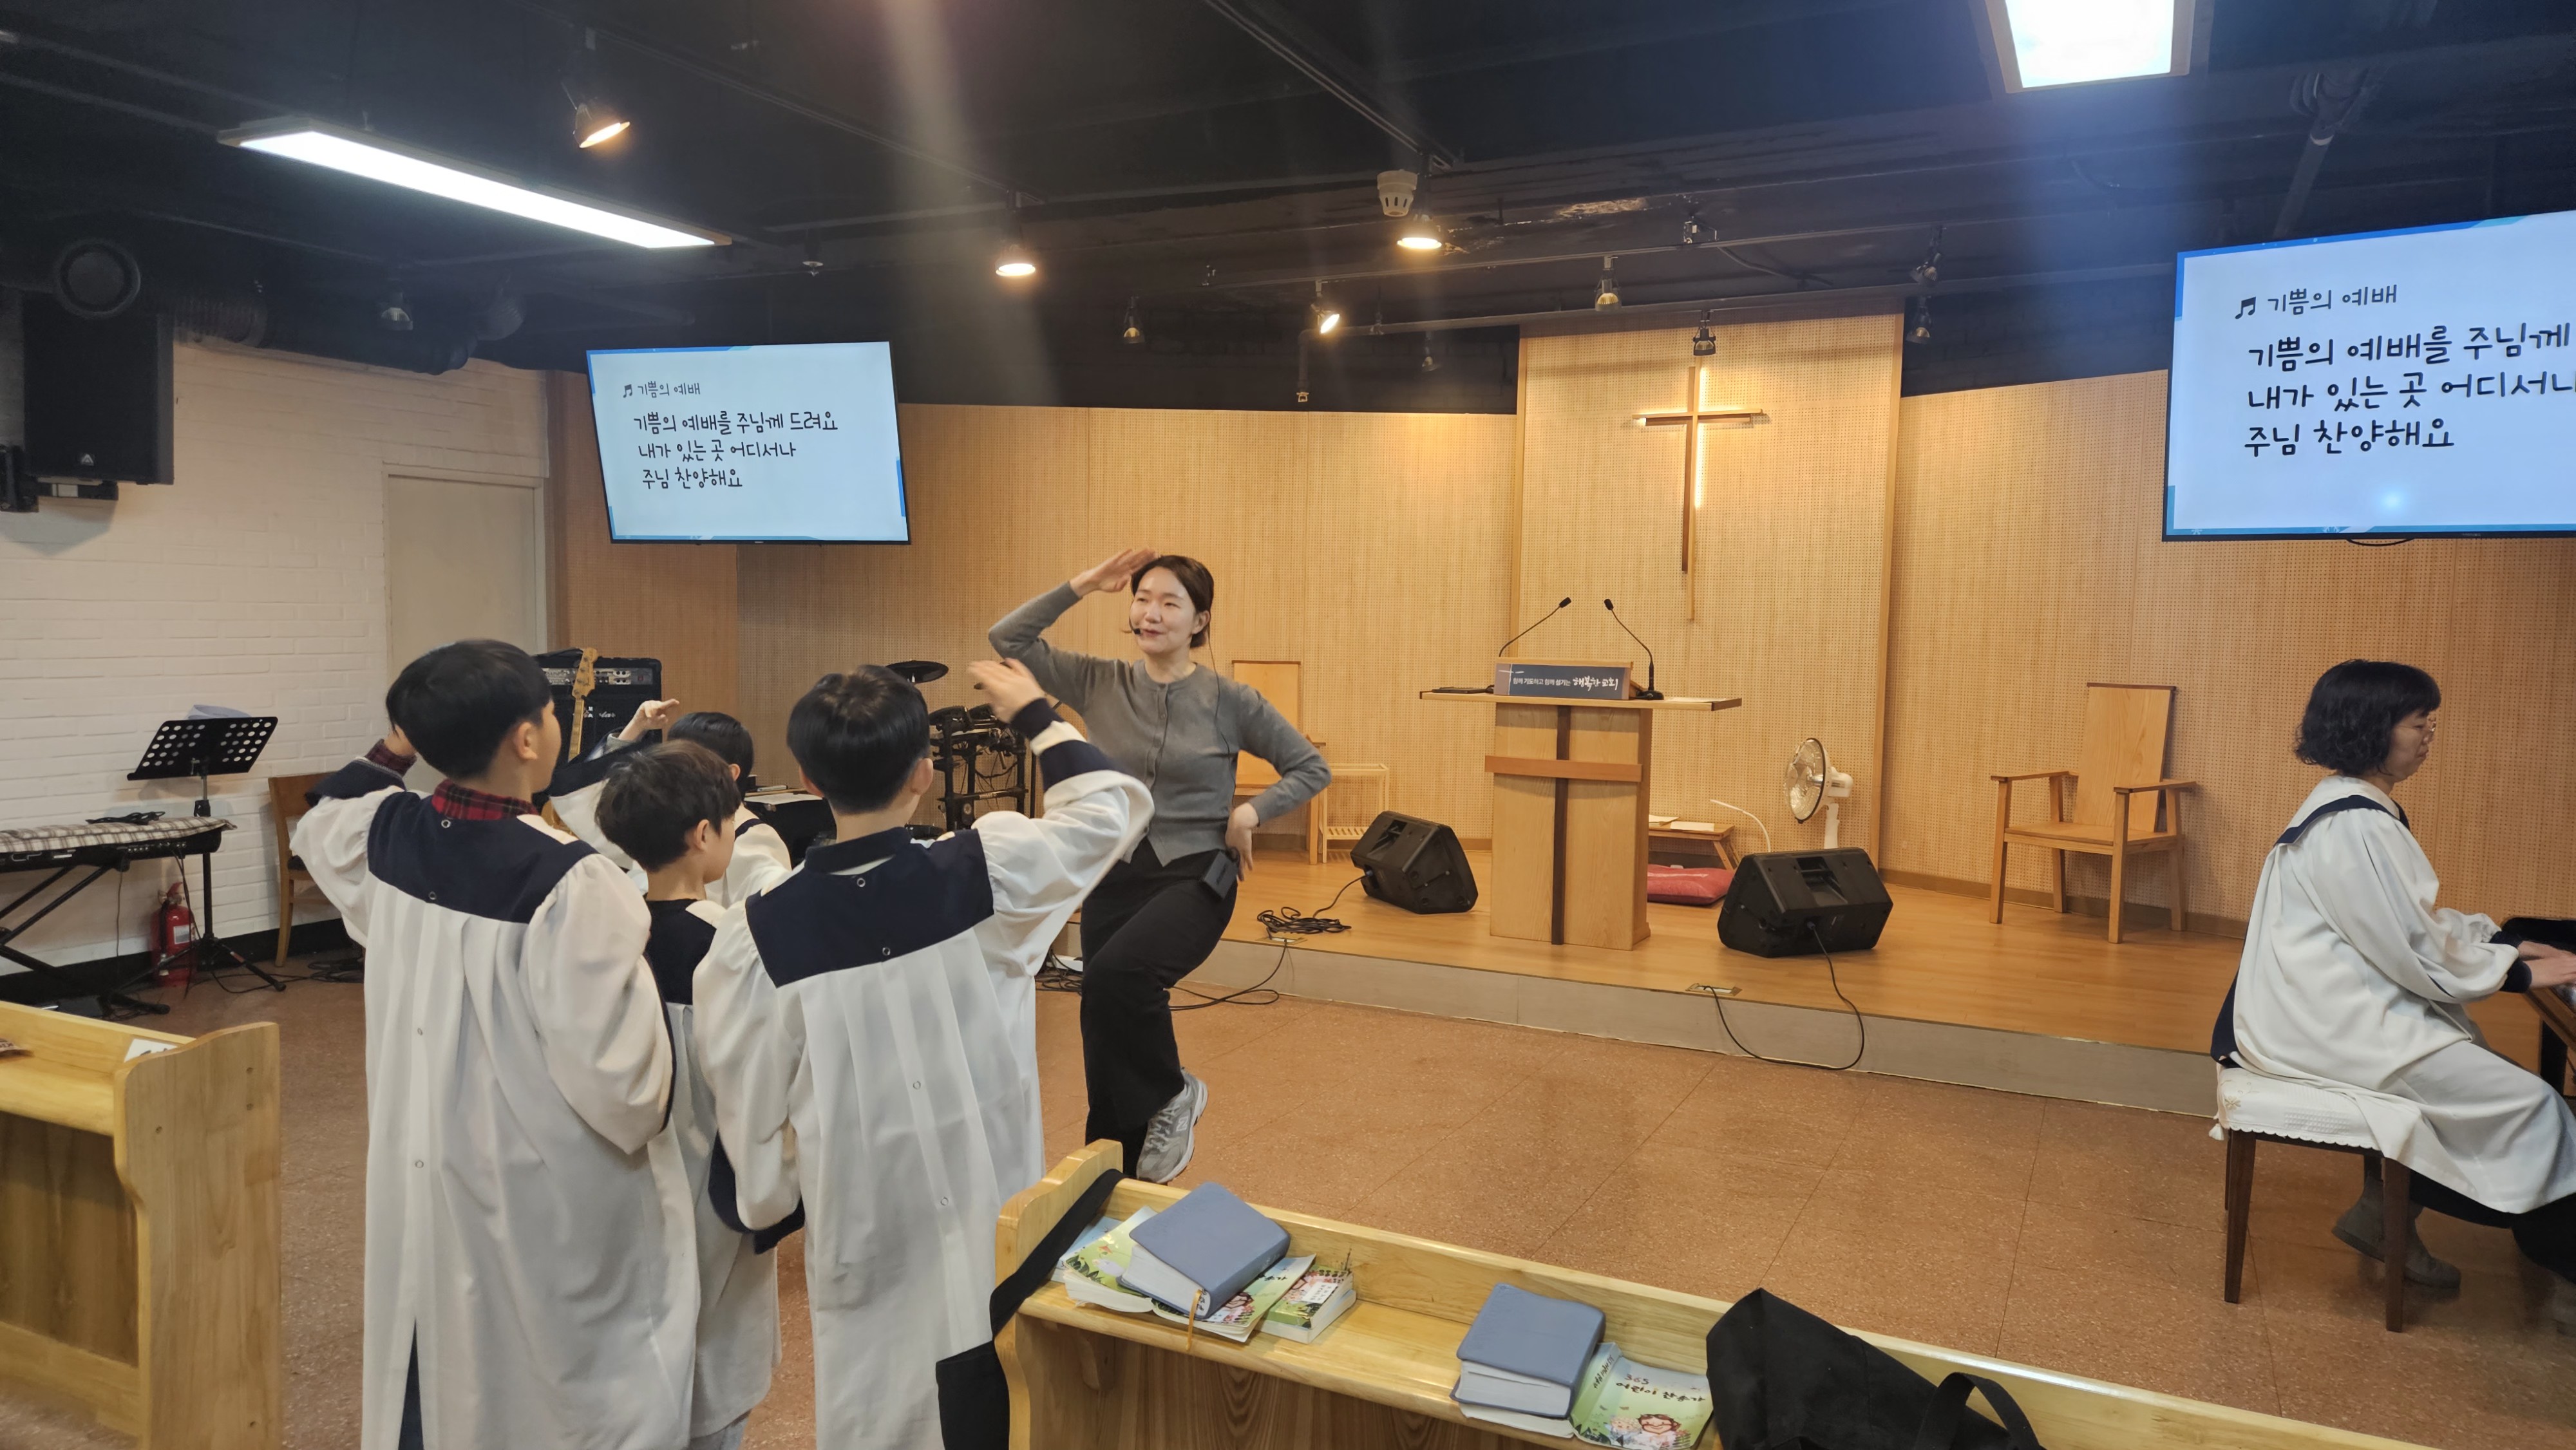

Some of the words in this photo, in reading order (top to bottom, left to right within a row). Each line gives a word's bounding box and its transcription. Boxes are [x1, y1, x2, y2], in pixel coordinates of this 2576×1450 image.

[2269, 289, 2332, 315] 기쁨의
[2343, 285, 2397, 306] 예배
[2249, 337, 2334, 372] 기쁨의
[2348, 326, 2452, 364] 예배를
[2465, 324, 2570, 361] 주님께
[639, 382, 670, 398] 기쁨의
[675, 383, 701, 395] 예배
[2249, 386, 2315, 410] 내가
[2328, 377, 2389, 412] 있는
[2400, 373, 2427, 408] 곳
[635, 413, 677, 435] 기쁨의
[683, 411, 732, 435] 예배를
[737, 413, 784, 434] 주님께
[791, 412, 838, 430] 드려요
[2246, 424, 2300, 458] 주님
[2314, 419, 2455, 454] 찬양해요
[639, 444, 671, 458] 내가
[677, 441, 706, 462] 있는
[712, 440, 724, 462] 곳
[732, 443, 797, 457] 어디서나
[643, 470, 669, 489] 주님
[676, 467, 743, 489] 찬양해요
[1573, 675, 1601, 692] 행복한
[1602, 677, 1618, 691] 교회
[1616, 1382, 1657, 1395] 어린이
[1624, 1373, 1649, 1385] 365
